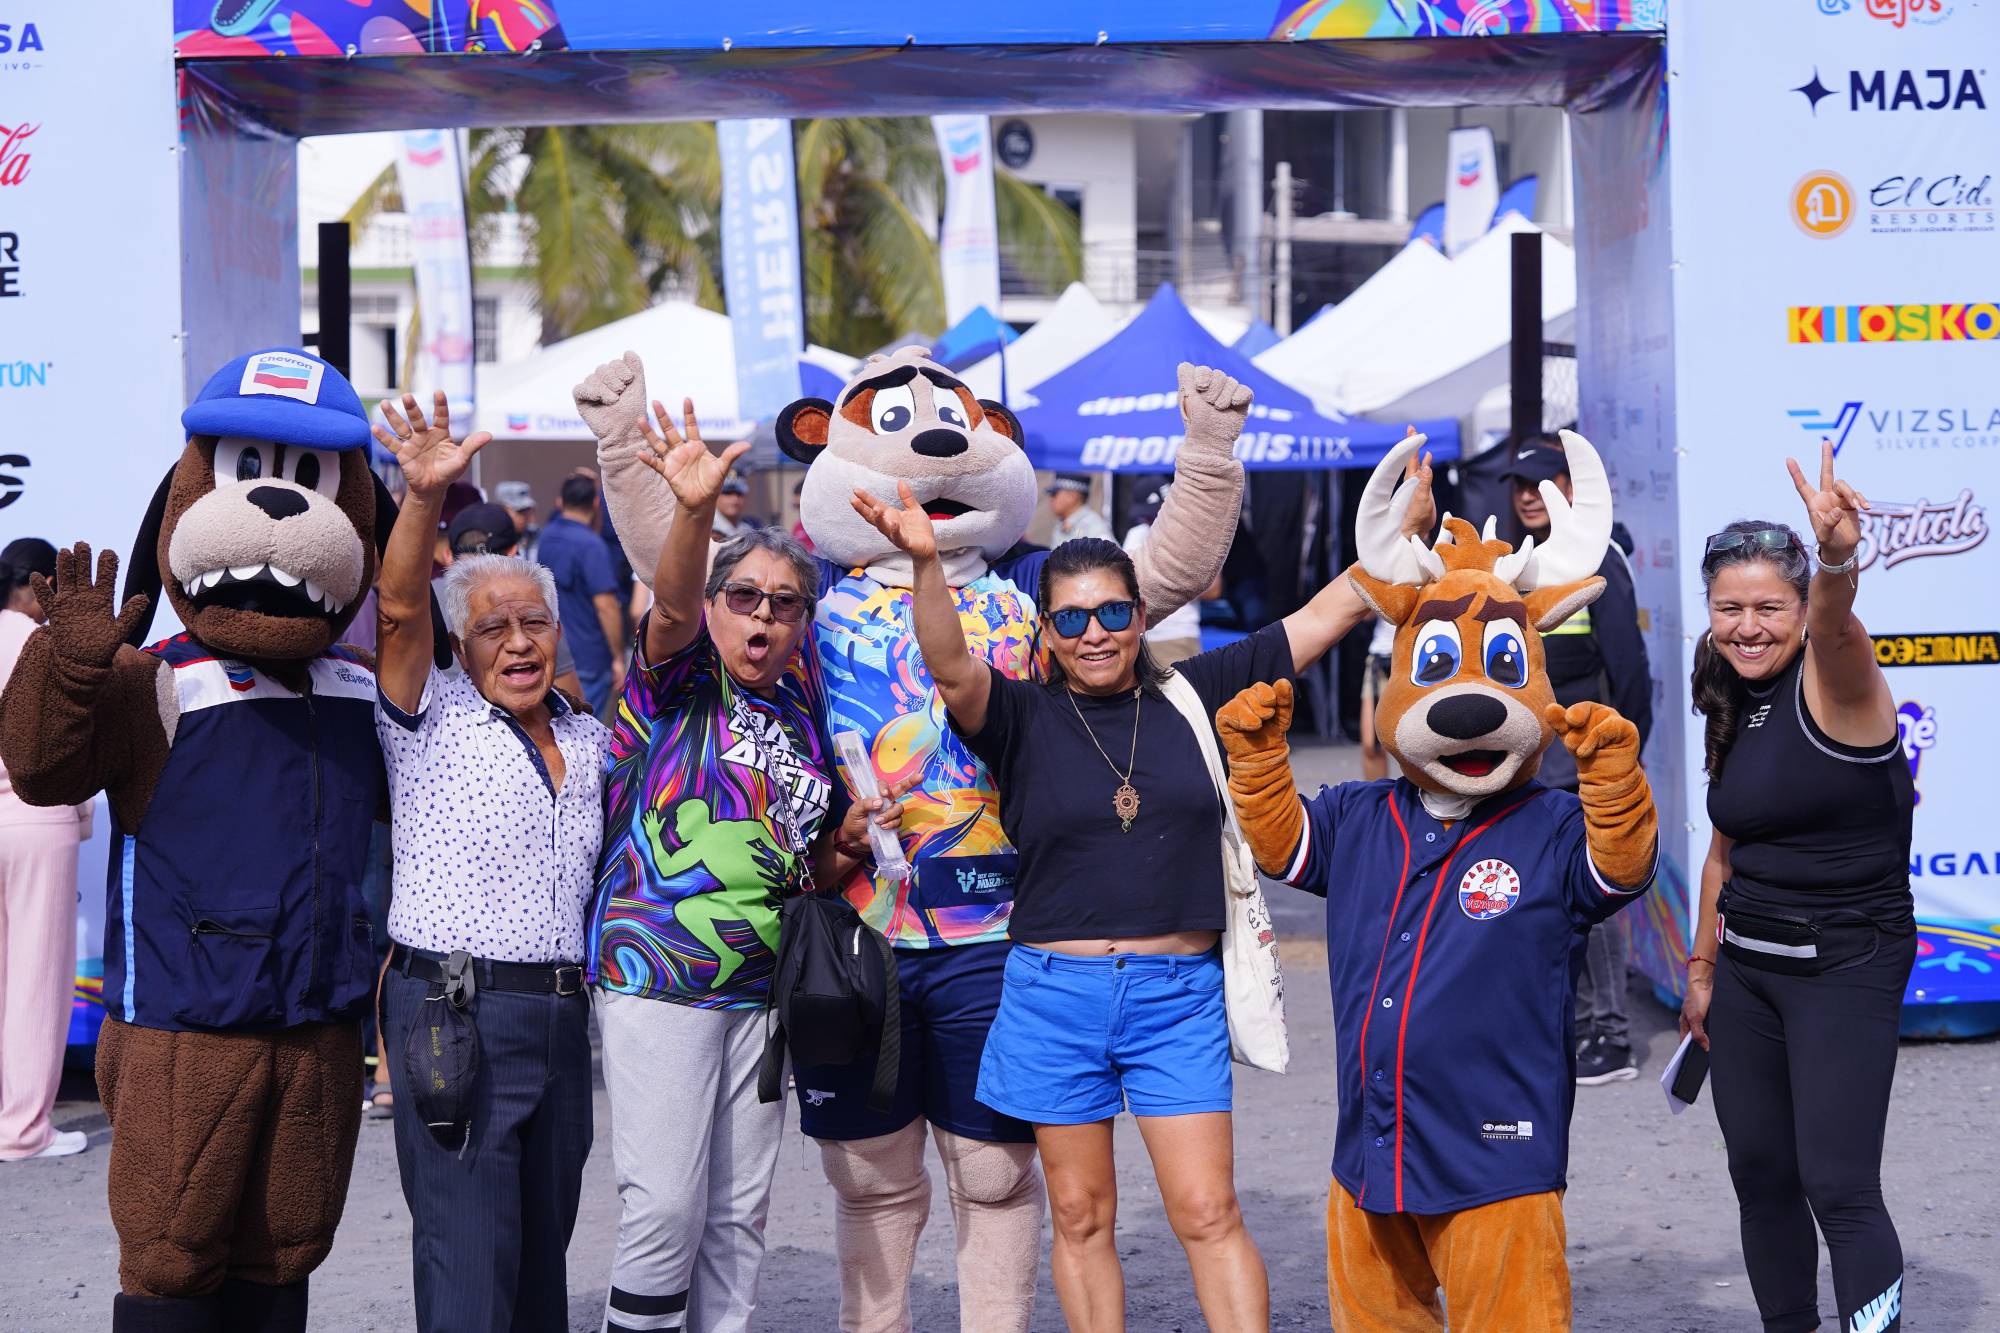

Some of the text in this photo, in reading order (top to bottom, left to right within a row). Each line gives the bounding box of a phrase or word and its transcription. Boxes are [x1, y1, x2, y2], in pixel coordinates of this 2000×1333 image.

[1850, 69, 1986, 111] MAJA
[1869, 174, 1991, 207] El Cid
[1871, 212, 1994, 225] RESORTS
[1787, 303, 2000, 343] KIOSKO
[260, 355, 313, 370] Chevron
[1868, 408, 2000, 433] VIZSLA
[1875, 436, 1941, 451] SILVER
